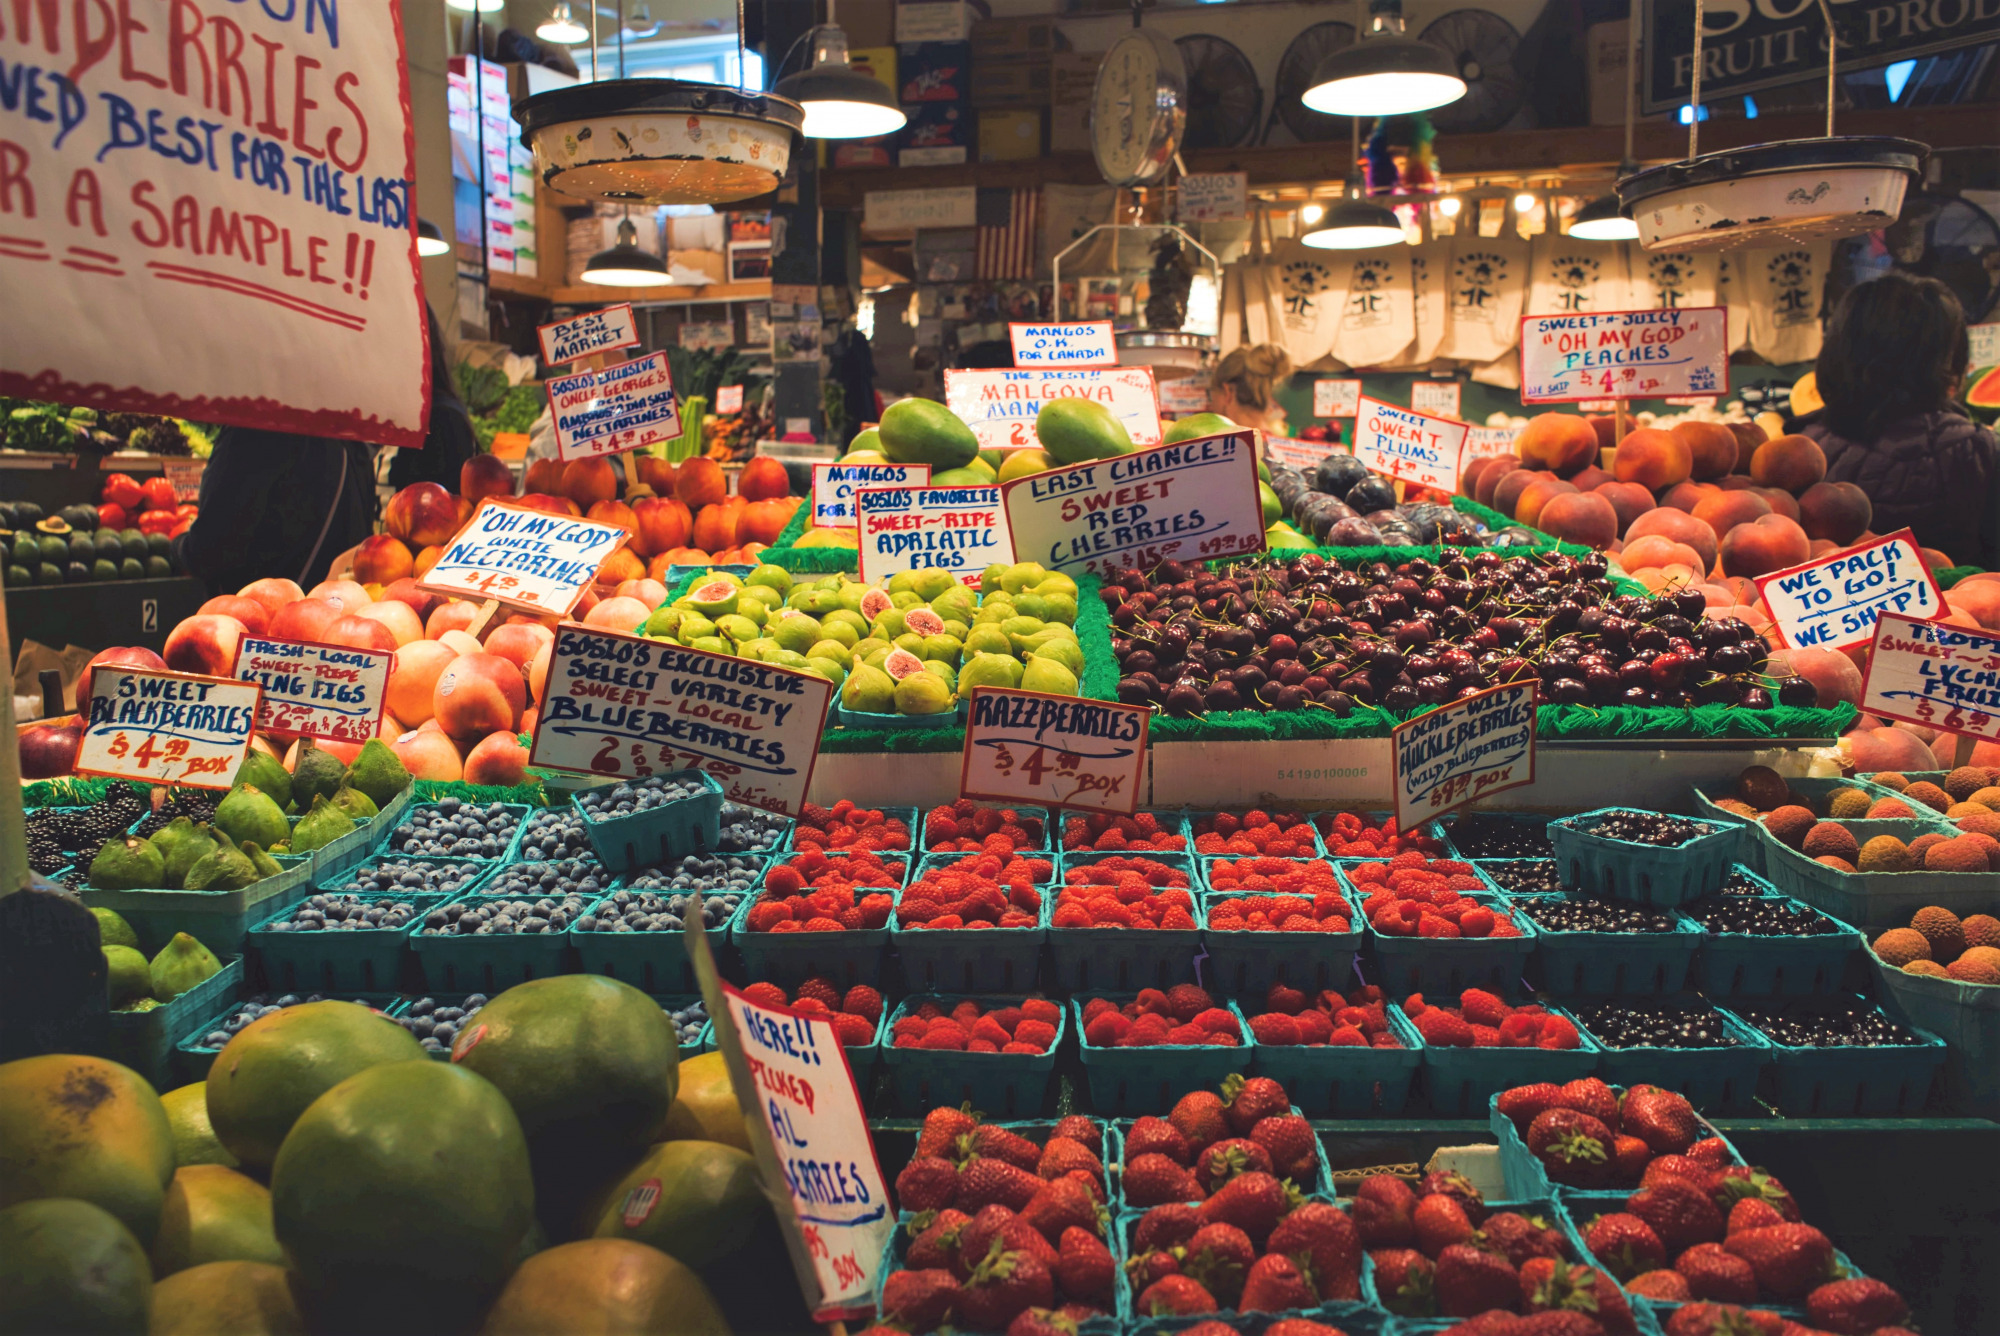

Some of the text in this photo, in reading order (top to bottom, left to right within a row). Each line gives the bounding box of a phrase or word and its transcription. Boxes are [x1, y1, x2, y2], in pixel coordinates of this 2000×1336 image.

[1671, 26, 1808, 88] FRUIT
[1818, 21, 1855, 52] &
[95, 91, 223, 172] BEST
[230, 131, 291, 195] FOR
[291, 155, 353, 216] THE
[355, 174, 412, 230] LAST
[65, 168, 108, 237] A
[130, 179, 376, 301] SAMPLE!!
[552, 312, 607, 343] BEST
[561, 322, 610, 344] IN THE
[1025, 326, 1096, 337] MANGOS
[1034, 337, 1075, 349] O.K.
[1597, 329, 1633, 350] MY
[553, 326, 625, 363] MARKET
[1018, 347, 1106, 361] FOR CANADA
[1563, 344, 1671, 369] PEACHES
[552, 357, 657, 397] SOSIO'S EXCLUSIVE
[603, 370, 667, 399] GEORGE'S
[999, 371, 1034, 381] THE
[1547, 381, 1571, 394] SHIP
[980, 383, 1115, 403] MALGOVA
[571, 406, 672, 442] NECTARINES
[986, 401, 1039, 419] MAN
[1377, 406, 1428, 428] SWEET
[1368, 417, 1423, 443] OWEN
[1373, 433, 1440, 463] PLUMS
[827, 466, 908, 483] MANGOS
[1031, 466, 1097, 499] LAST
[817, 503, 847, 518] FOR
[860, 488, 913, 511] SOSIO'S
[918, 487, 1000, 506] FAVORITE
[1061, 477, 1175, 523] SWEET
[517, 516, 565, 541] MY
[1083, 504, 1148, 532] RED
[486, 536, 556, 555] WHITE
[877, 528, 998, 557] ADRIATIC
[1050, 509, 1206, 565] CHERRIES
[442, 541, 600, 587] NECTARINES
[910, 551, 965, 570] FIGS
[1778, 540, 1903, 595] WE PACK
[1794, 562, 1898, 611] TO GO!
[144, 602, 156, 631] 2
[1794, 581, 1929, 648] WE SHIP!
[557, 632, 805, 695] SOSIO'S EXCLUSIVE
[1919, 659, 2000, 691] LYCH
[117, 675, 218, 703] SWEET
[241, 670, 366, 704] KING FIGS
[567, 658, 793, 727] SELECT VARIETY
[90, 695, 254, 737] BLACKBERRIES
[541, 695, 786, 766] BLUEBERRIES
[974, 694, 1141, 742] RAZZBERRIES
[590, 736, 621, 772] 2
[1400, 701, 1534, 778] HUCKLEBERRIES
[179, 755, 234, 779] BOX
[1406, 724, 1530, 795] (WILD BLUEBERRIES)
[1064, 772, 1126, 803] BOX
[1473, 765, 1514, 796] BOX
[742, 1006, 822, 1066] HERE!!
